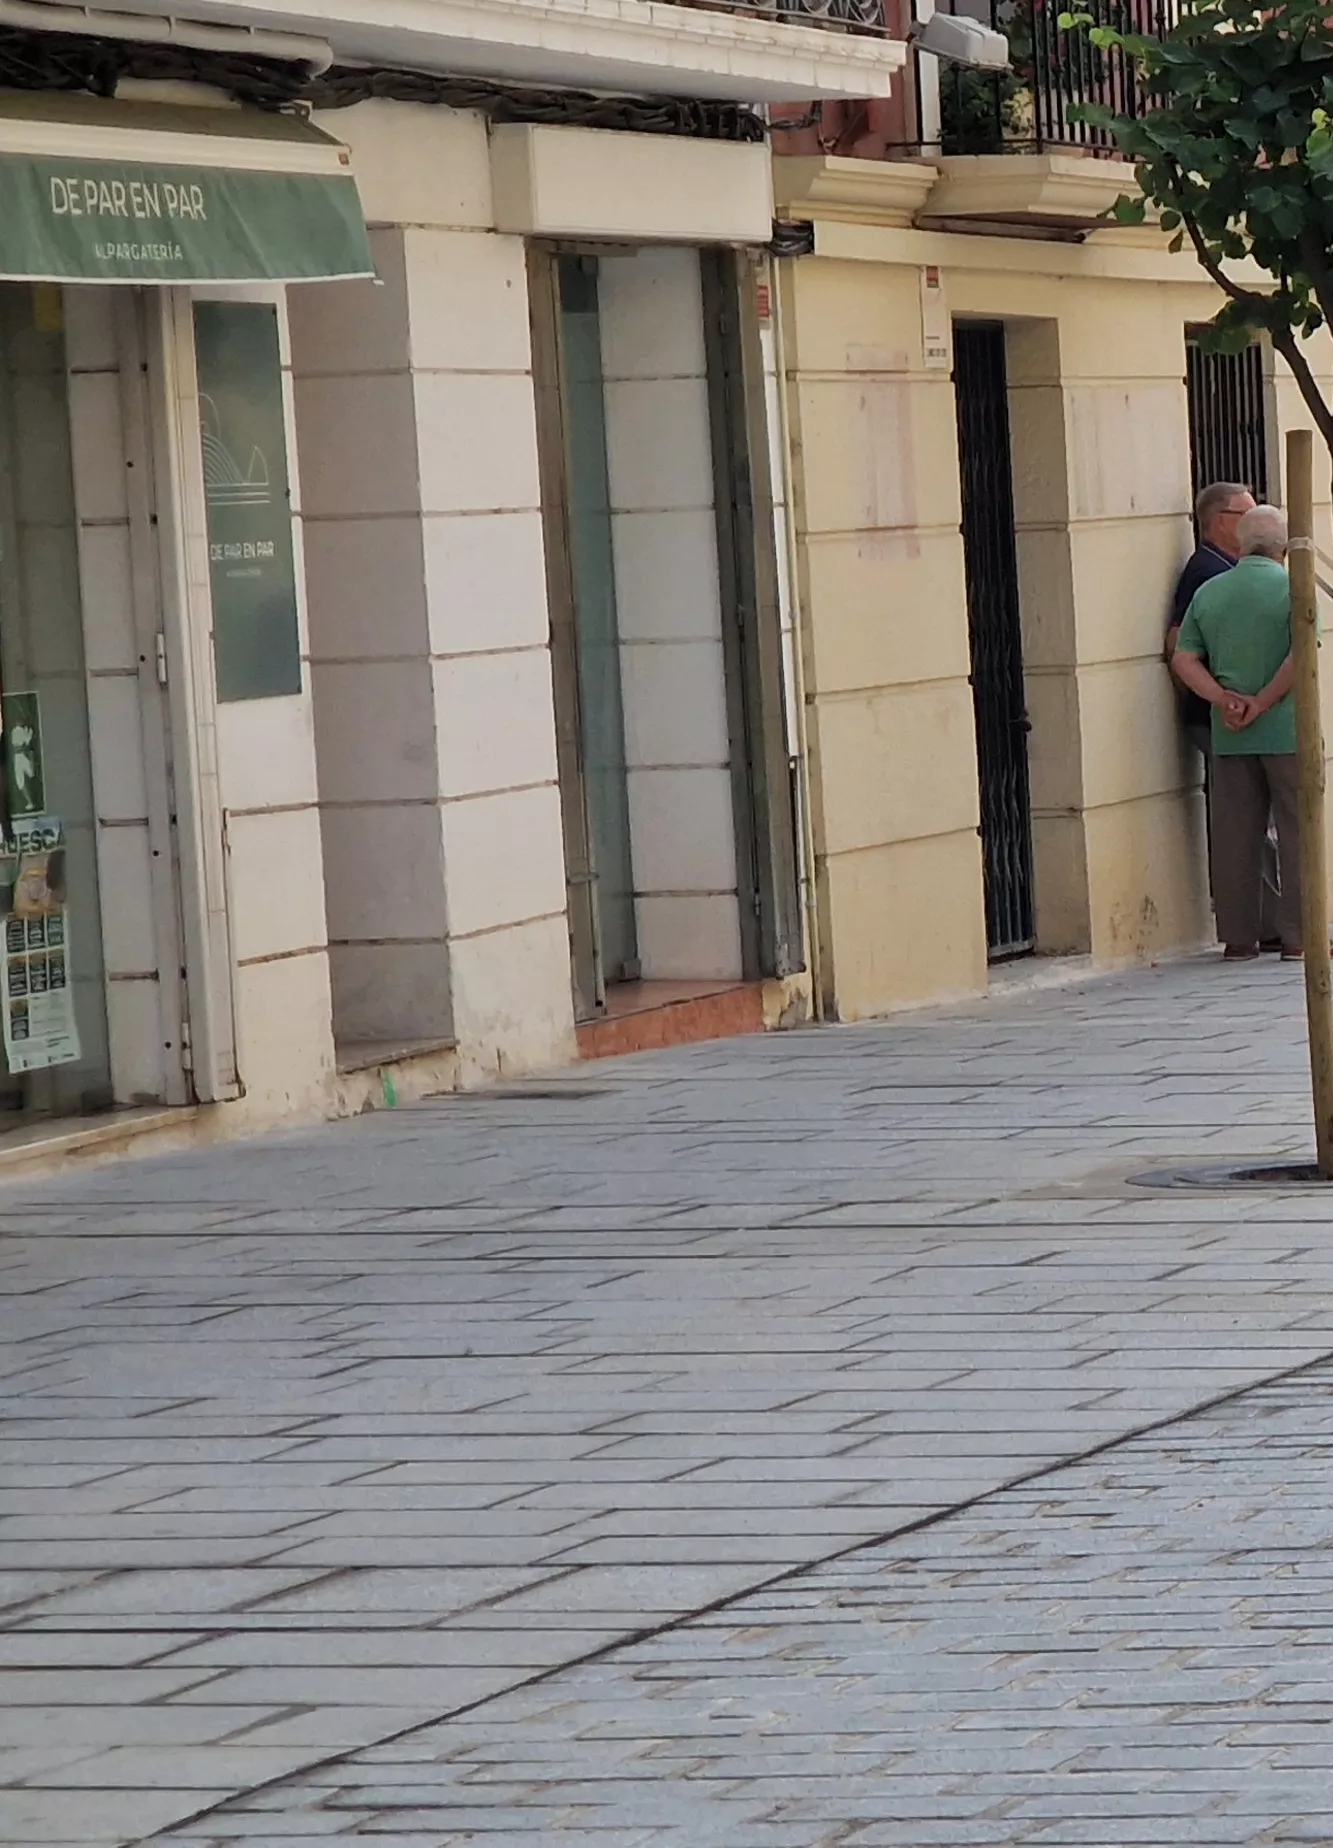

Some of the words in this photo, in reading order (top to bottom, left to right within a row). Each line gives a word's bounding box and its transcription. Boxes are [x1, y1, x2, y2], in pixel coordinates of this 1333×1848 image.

[50, 176, 82, 215] DE
[84, 179, 128, 217] PAR
[129, 182, 161, 219] EN
[162, 183, 207, 220] PAR
